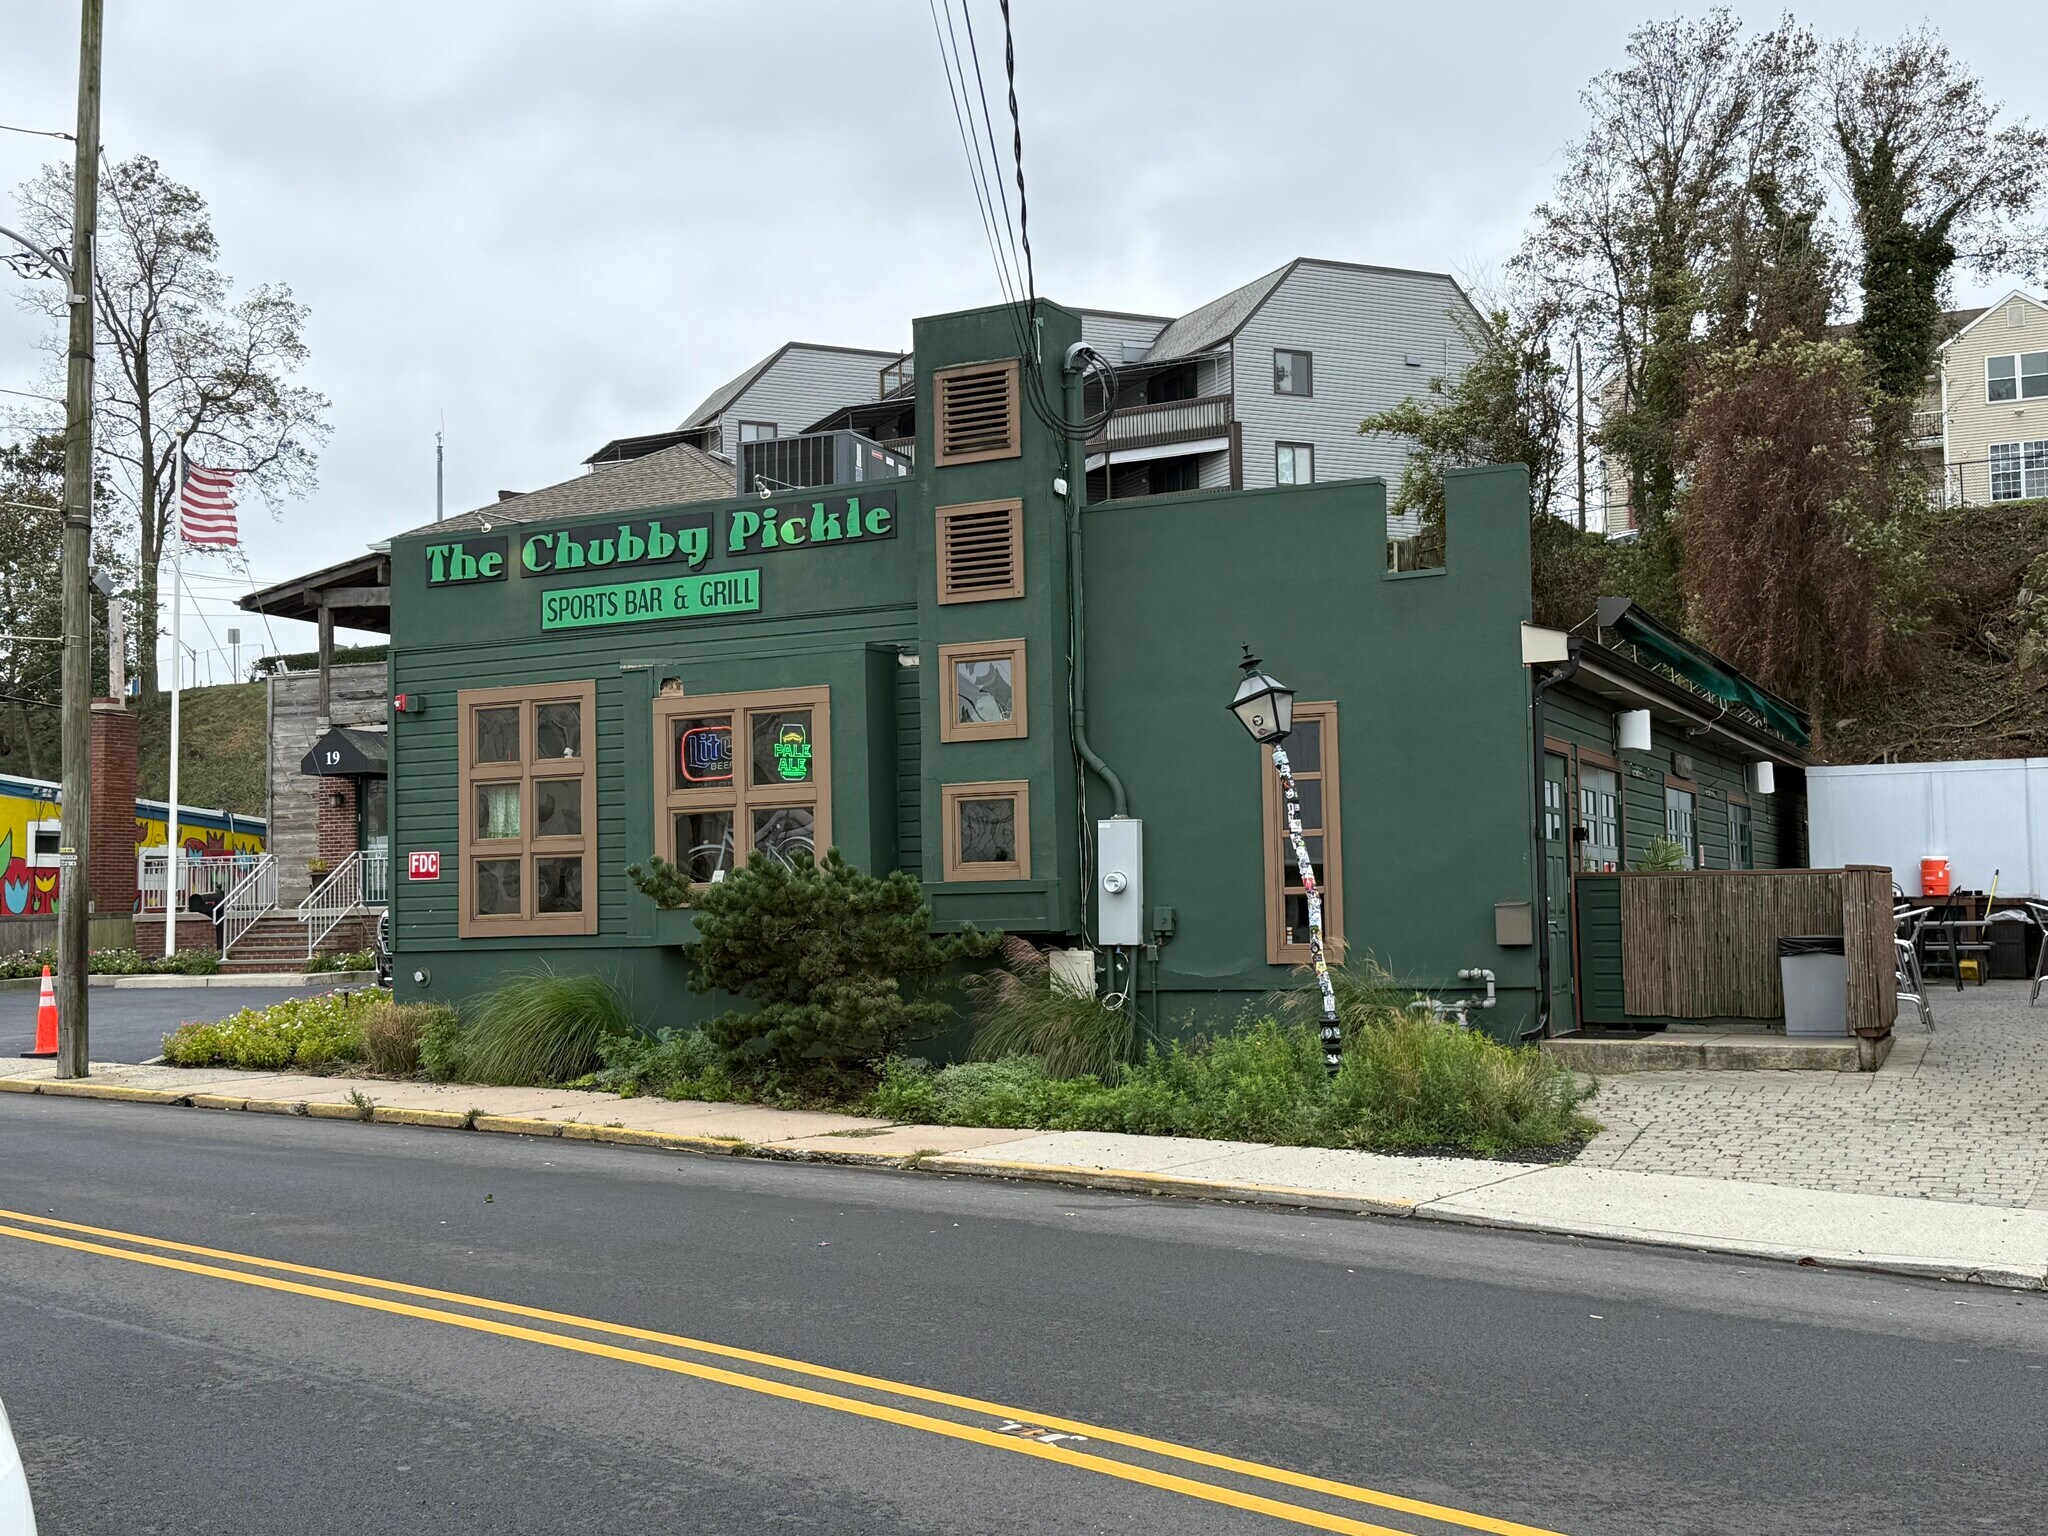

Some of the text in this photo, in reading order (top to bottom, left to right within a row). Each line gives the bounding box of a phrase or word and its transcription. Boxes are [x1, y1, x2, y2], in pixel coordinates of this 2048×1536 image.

[426, 497, 892, 583] The Chubby Pickle
[546, 577, 754, 622] SPORTS BAR & GRILL
[325, 750, 341, 765] 19
[774, 743, 812, 758] PALE
[710, 761, 732, 771] BEE
[777, 758, 807, 771] ALE
[411, 854, 437, 873] FDC
